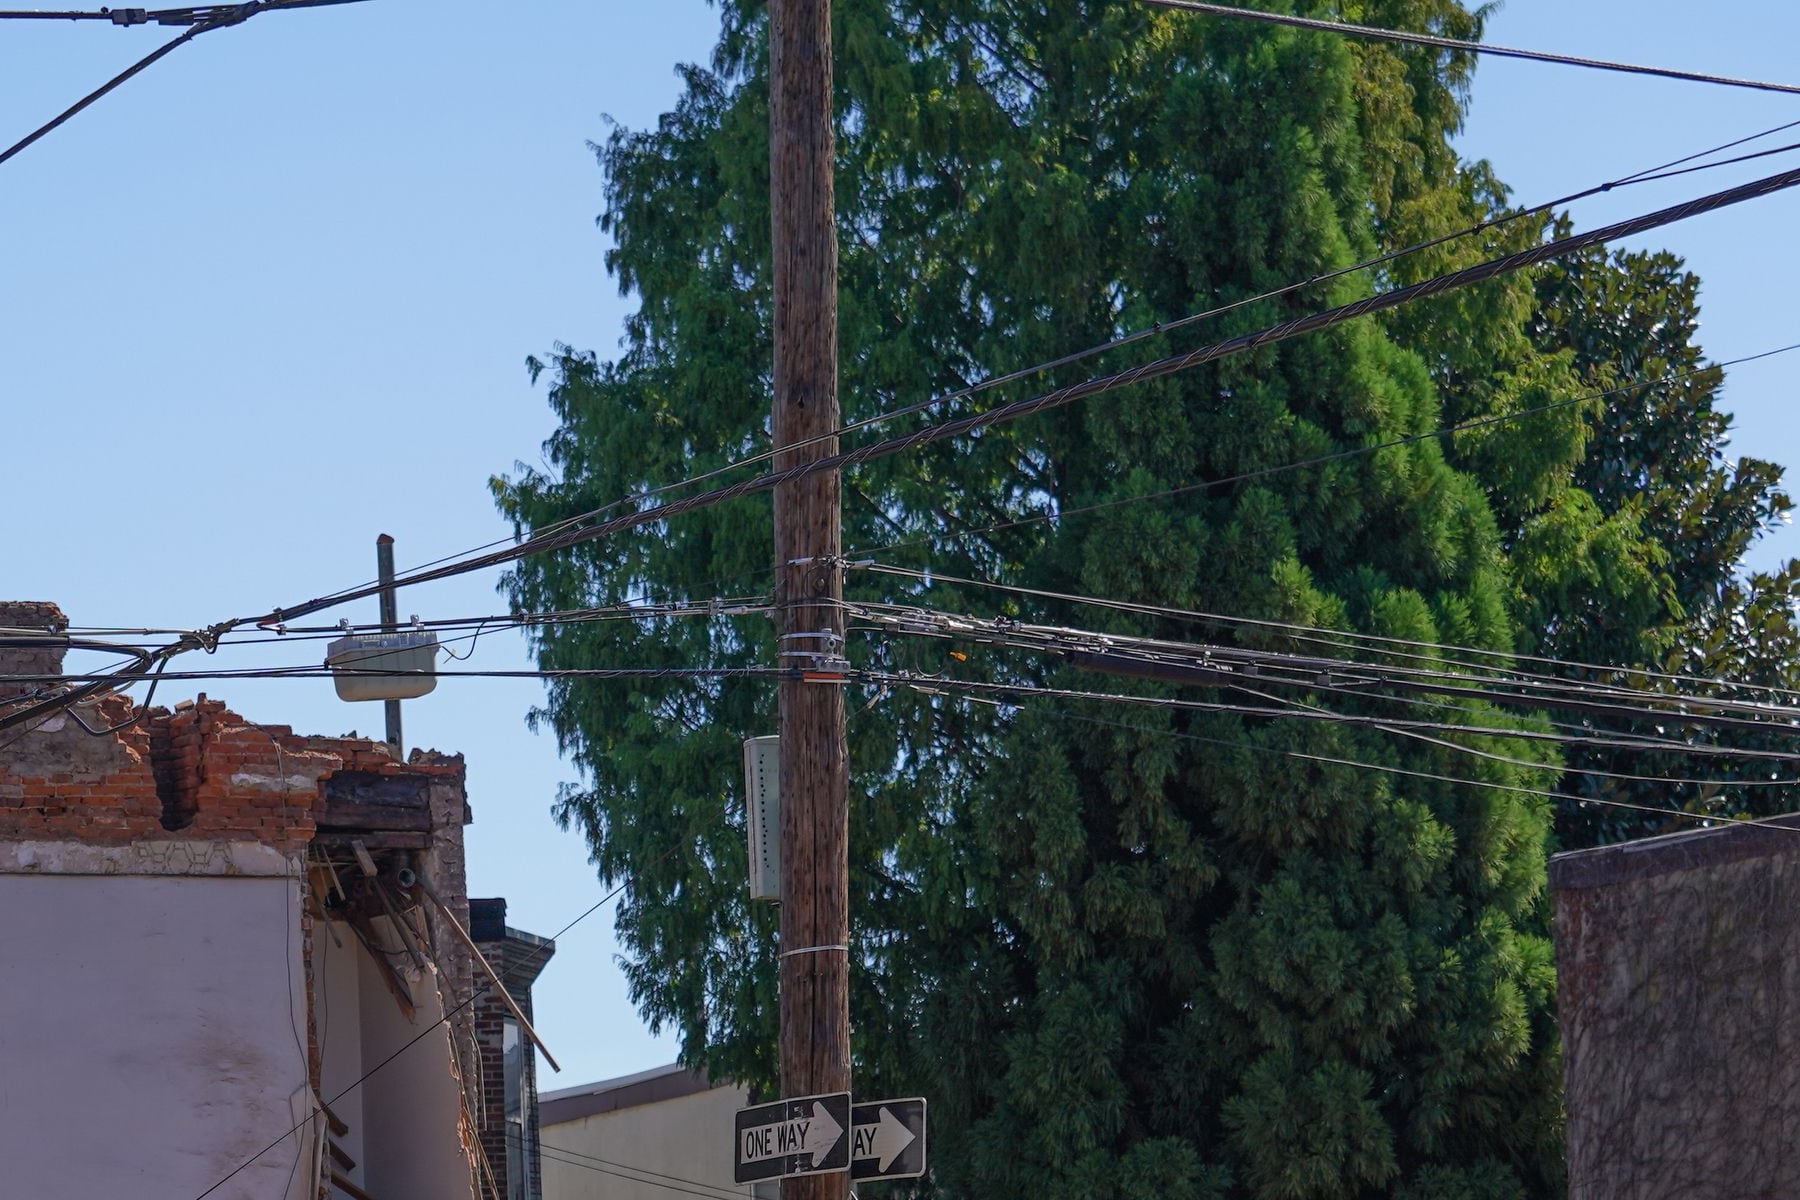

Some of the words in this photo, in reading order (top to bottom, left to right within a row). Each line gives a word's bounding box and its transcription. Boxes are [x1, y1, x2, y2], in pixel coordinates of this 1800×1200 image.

[746, 1128, 772, 1159] ONE
[777, 1121, 811, 1153] WAY
[853, 1127, 877, 1156] AY
